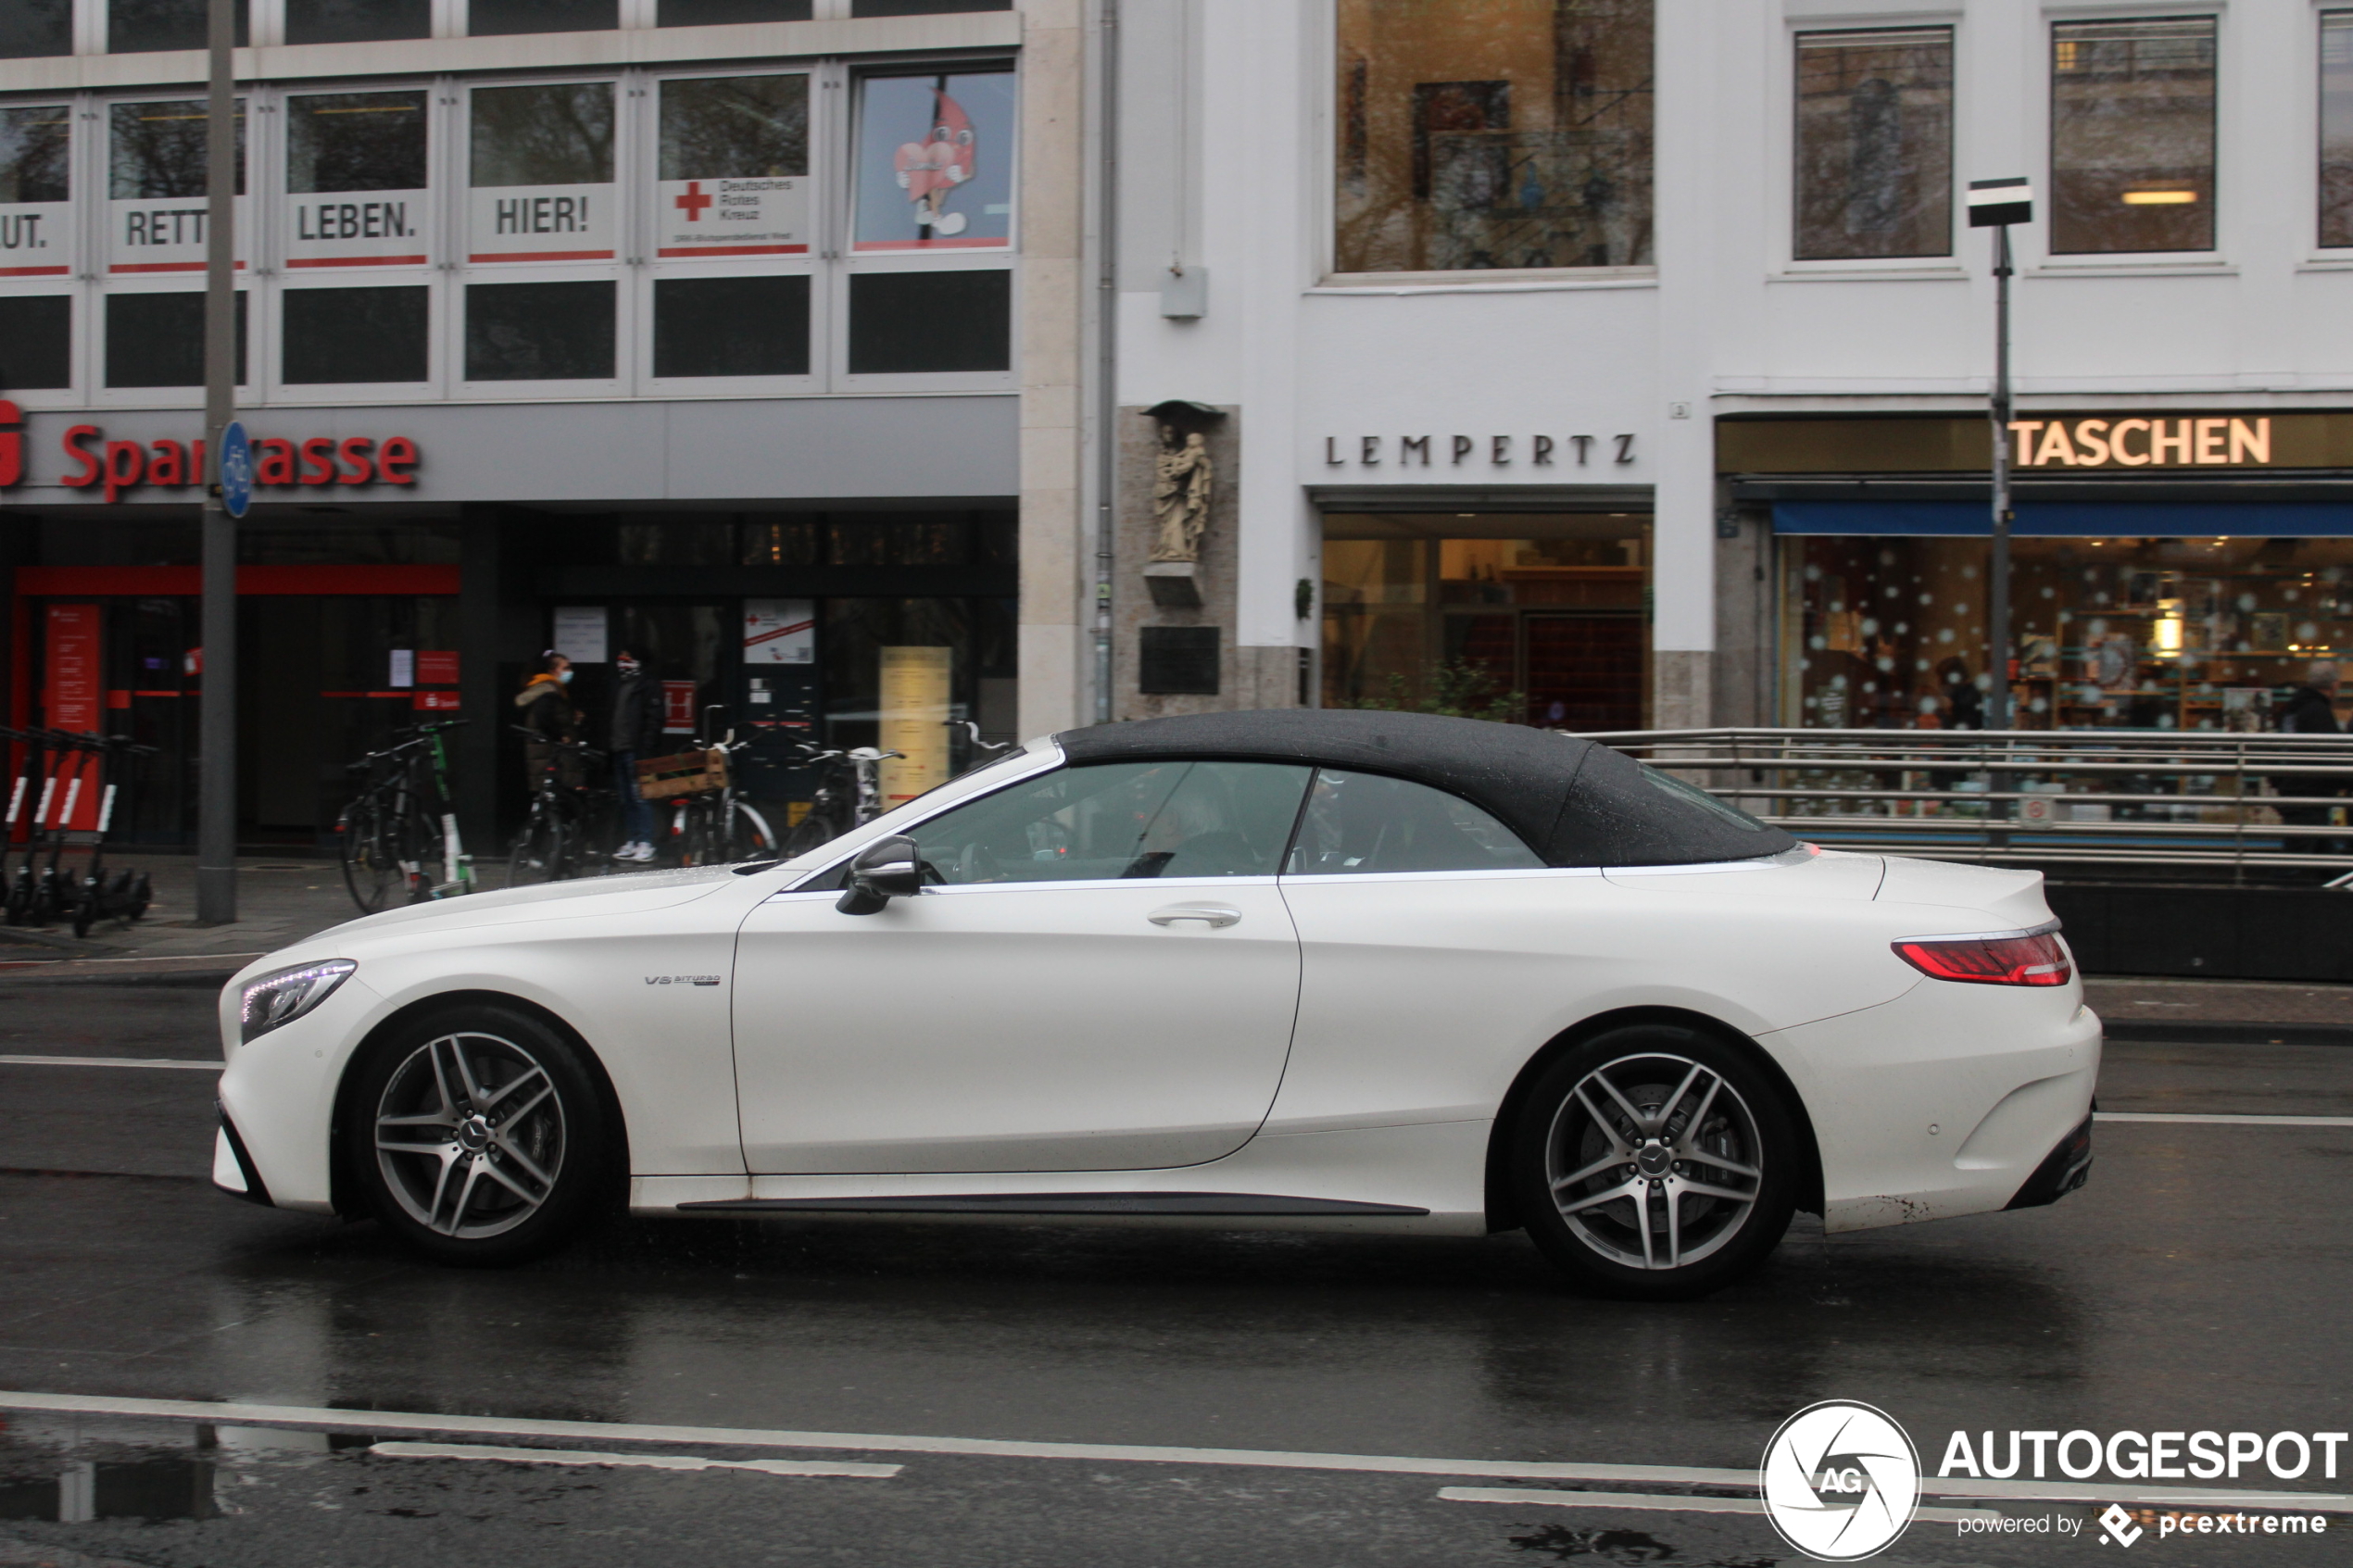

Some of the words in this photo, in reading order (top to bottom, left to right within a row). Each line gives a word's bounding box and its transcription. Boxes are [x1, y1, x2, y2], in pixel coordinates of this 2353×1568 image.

[719, 179, 793, 193] Deutsches
[719, 194, 760, 206] Rotes
[127, 209, 208, 245] RETT
[297, 201, 416, 241] LEBEN.
[496, 195, 589, 235] HIER!
[719, 208, 760, 220] Kreuz
[1325, 433, 1636, 466] LEMPERTZ
[2007, 418, 2270, 466] TASCHEN
[60, 424, 416, 503] Sparasse
